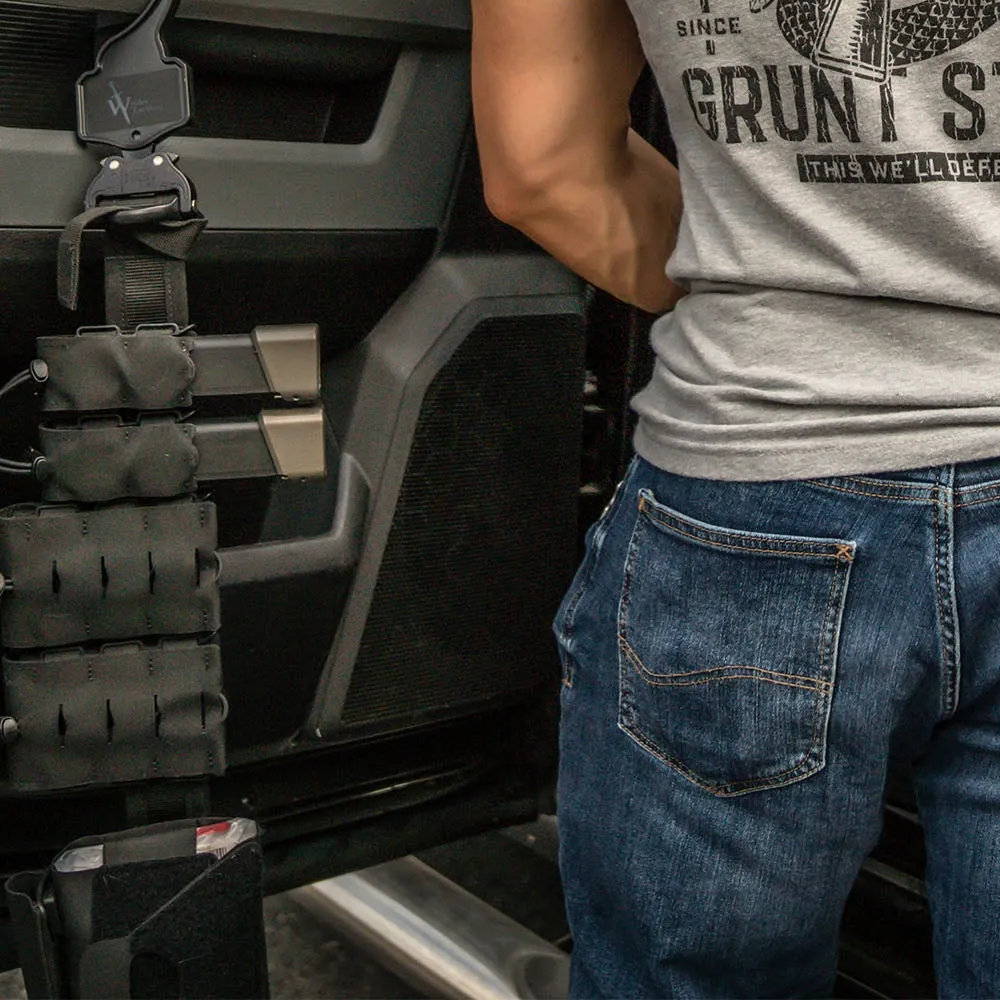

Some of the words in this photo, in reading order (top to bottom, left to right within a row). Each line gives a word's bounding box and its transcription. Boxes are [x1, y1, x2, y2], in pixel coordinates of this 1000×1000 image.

[676, 16, 742, 37] SINCE
[681, 64, 909, 144] GRUNT
[808, 160, 862, 178] THIS
[869, 158, 944, 178] WE'LL
